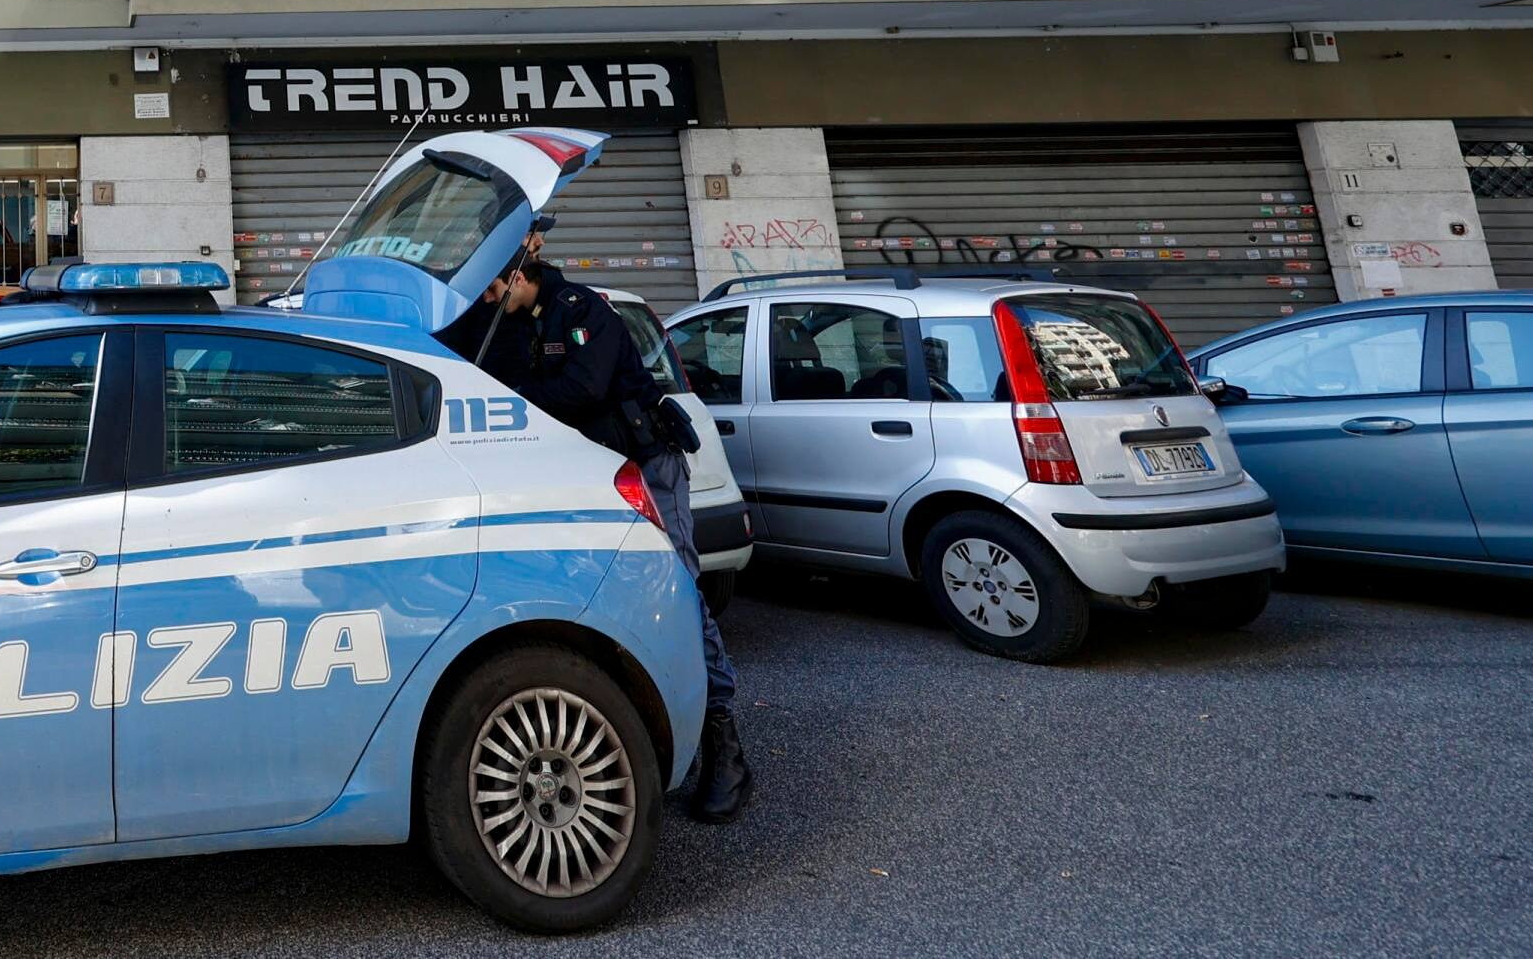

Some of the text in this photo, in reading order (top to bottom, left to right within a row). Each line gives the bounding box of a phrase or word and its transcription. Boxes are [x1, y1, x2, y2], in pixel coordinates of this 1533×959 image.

[245, 65, 470, 112] TREND
[390, 113, 531, 124] PARRUCCHIERI
[712, 180, 722, 195] 9
[1345, 174, 1360, 188] 11
[98, 187, 107, 200] 7
[444, 396, 529, 434] 113
